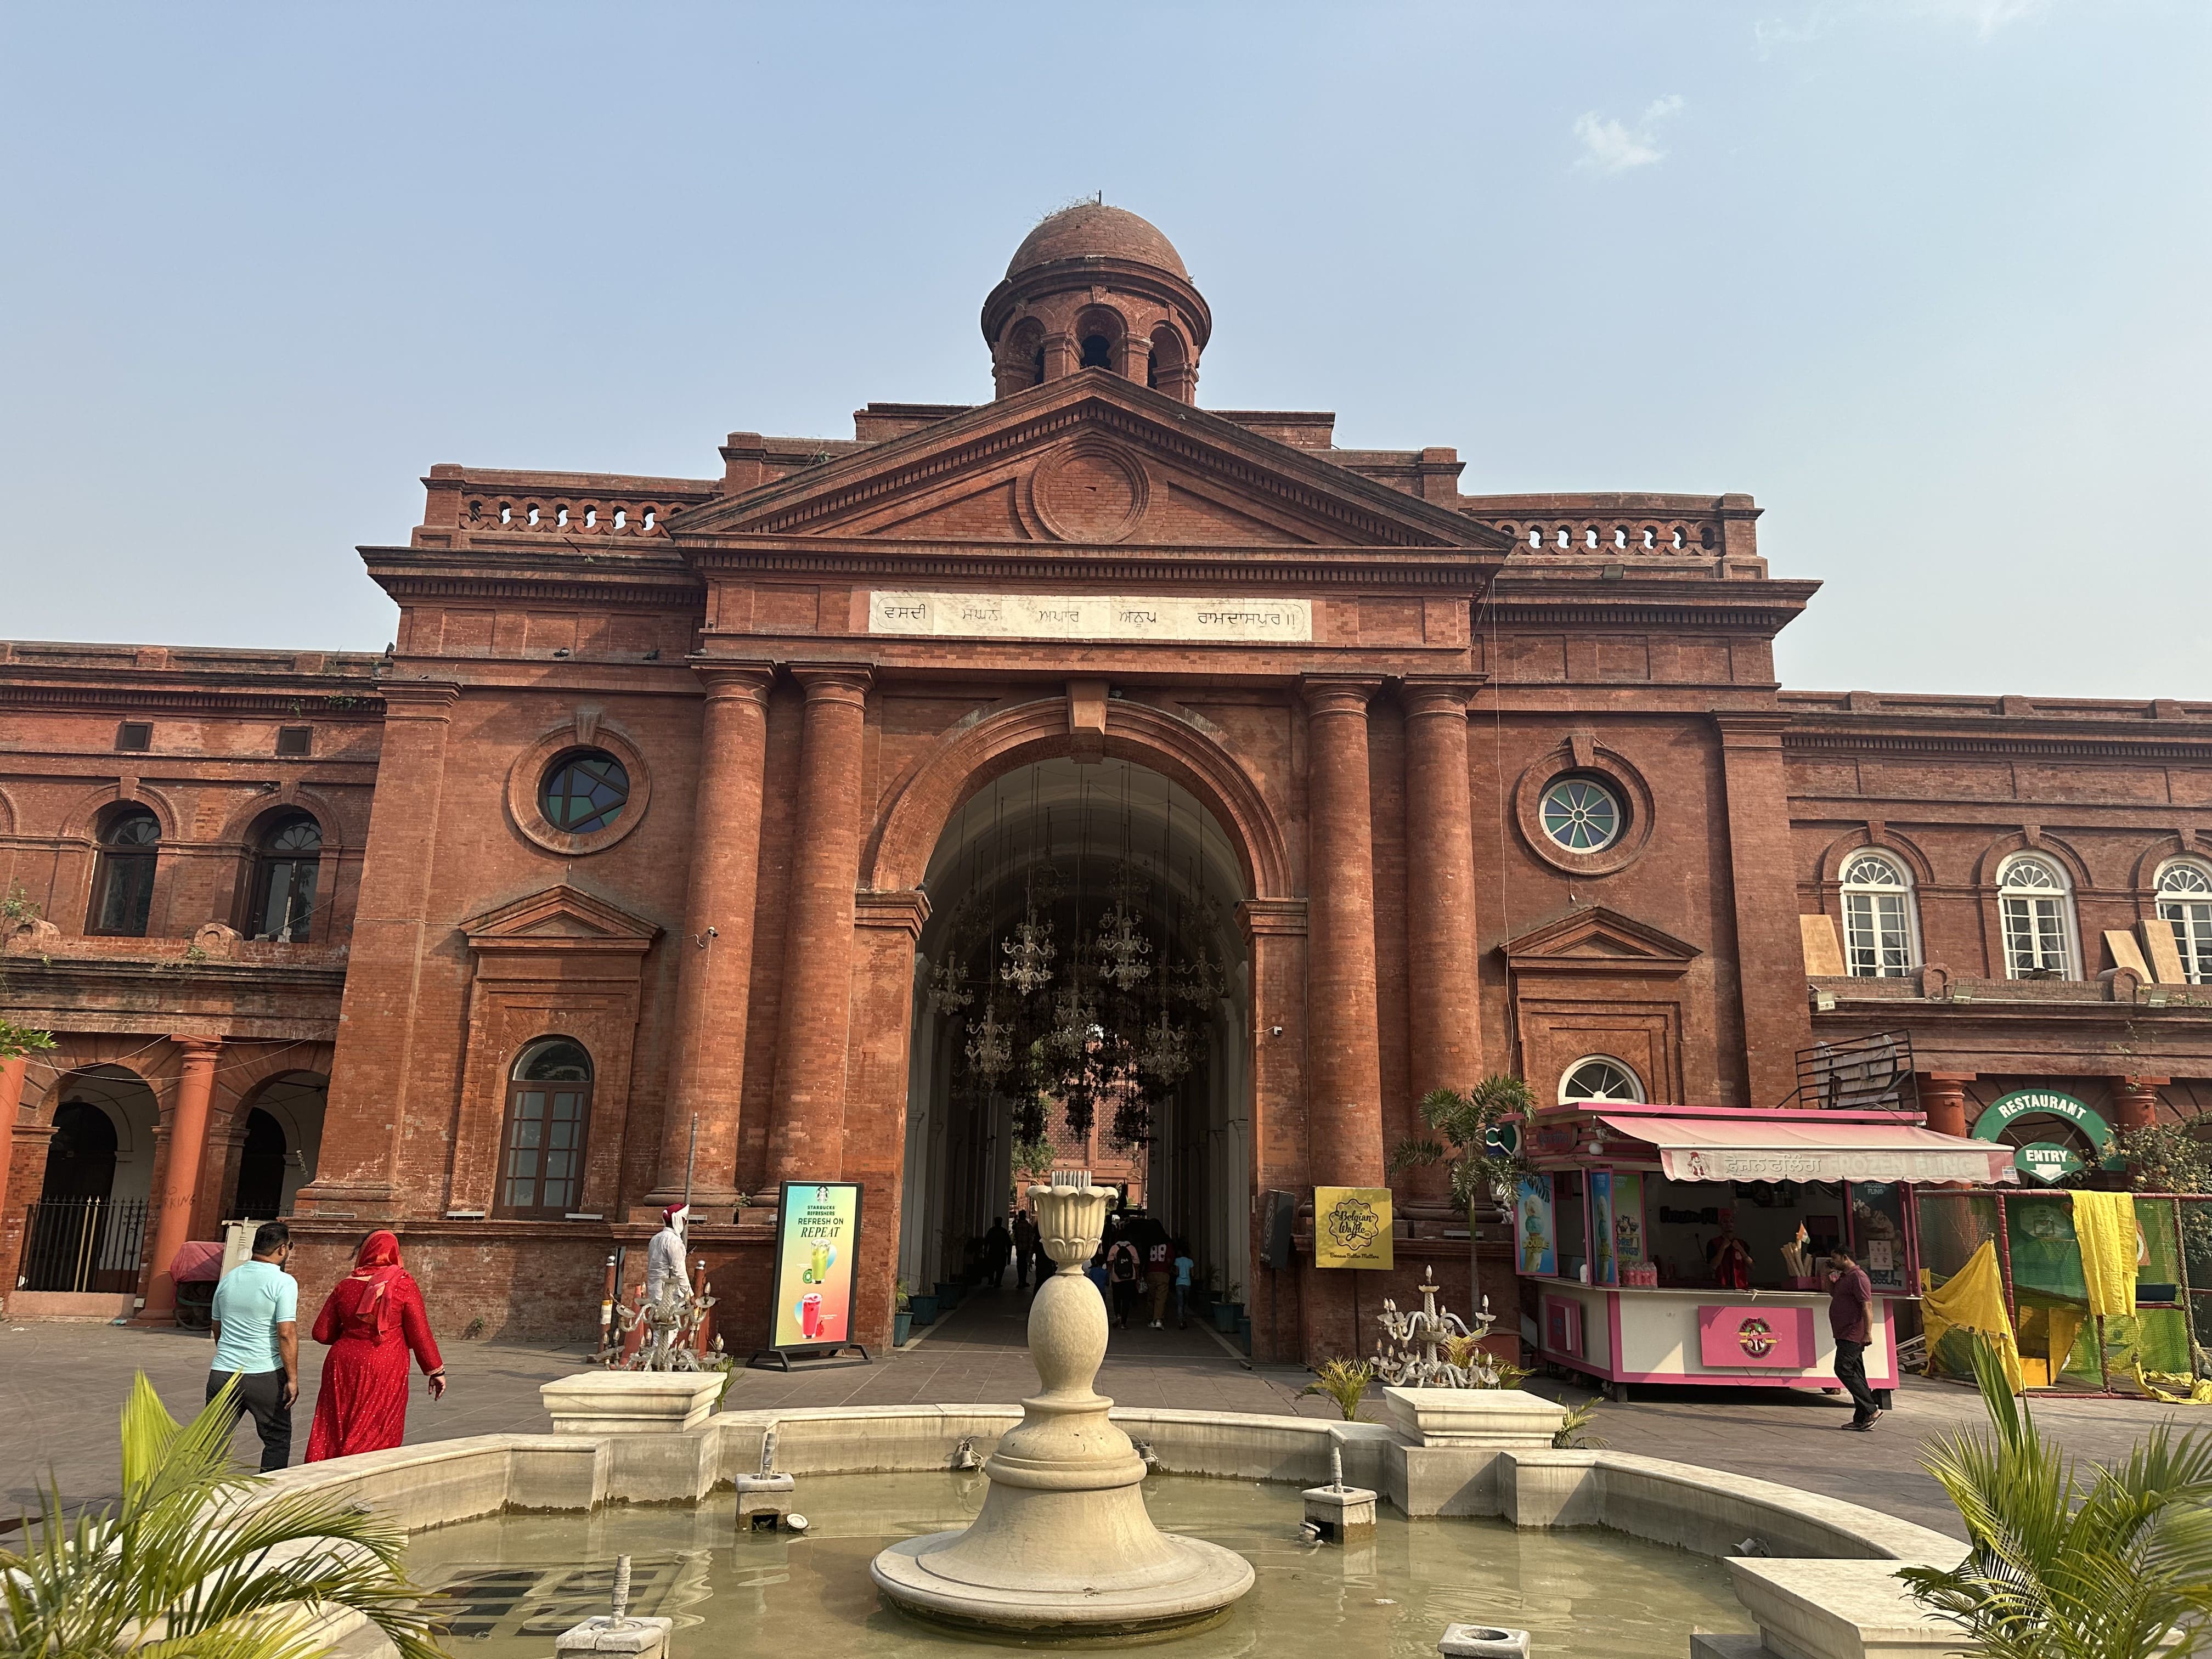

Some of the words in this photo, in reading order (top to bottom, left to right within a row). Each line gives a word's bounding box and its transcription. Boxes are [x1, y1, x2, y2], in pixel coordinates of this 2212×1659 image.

[884, 603, 926, 619] ਵਸਦੀ
[1039, 610, 1079, 623] ਅਪਾਰ
[1119, 611, 1156, 628] ਅਨੂਪ
[1998, 1094, 2086, 1120] RESTAURANT
[2025, 1149, 2068, 1163] ENTRY
[1828, 1155, 1906, 1175] FROZEN
[1914, 1155, 1975, 1177] FLING
[1335, 1210, 1372, 1223] Belgian
[800, 1227, 840, 1238] REPEAT
[1339, 1221, 1366, 1239] Waffle
